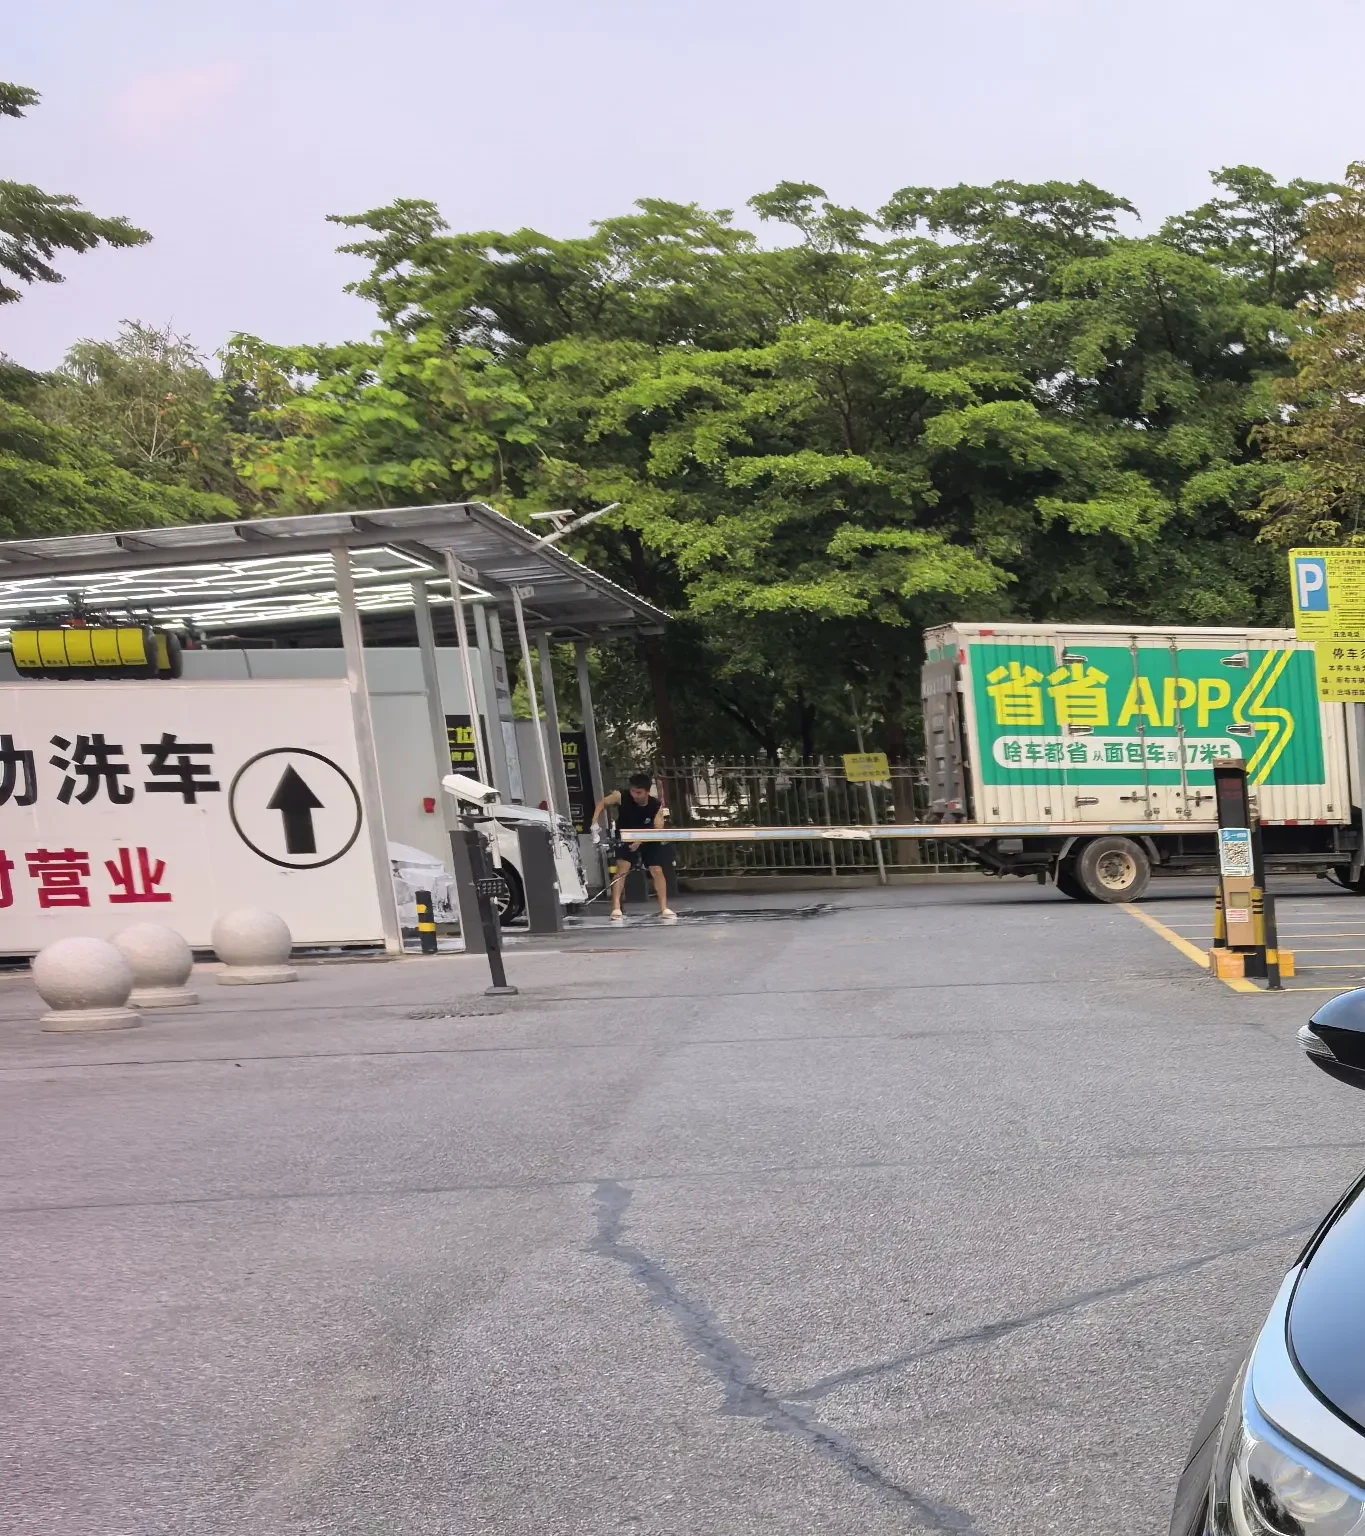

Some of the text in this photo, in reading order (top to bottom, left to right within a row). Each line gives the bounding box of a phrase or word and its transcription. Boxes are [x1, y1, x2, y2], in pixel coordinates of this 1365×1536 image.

[1297, 563, 1324, 608] P
[986, 661, 1232, 728] 省省 APP
